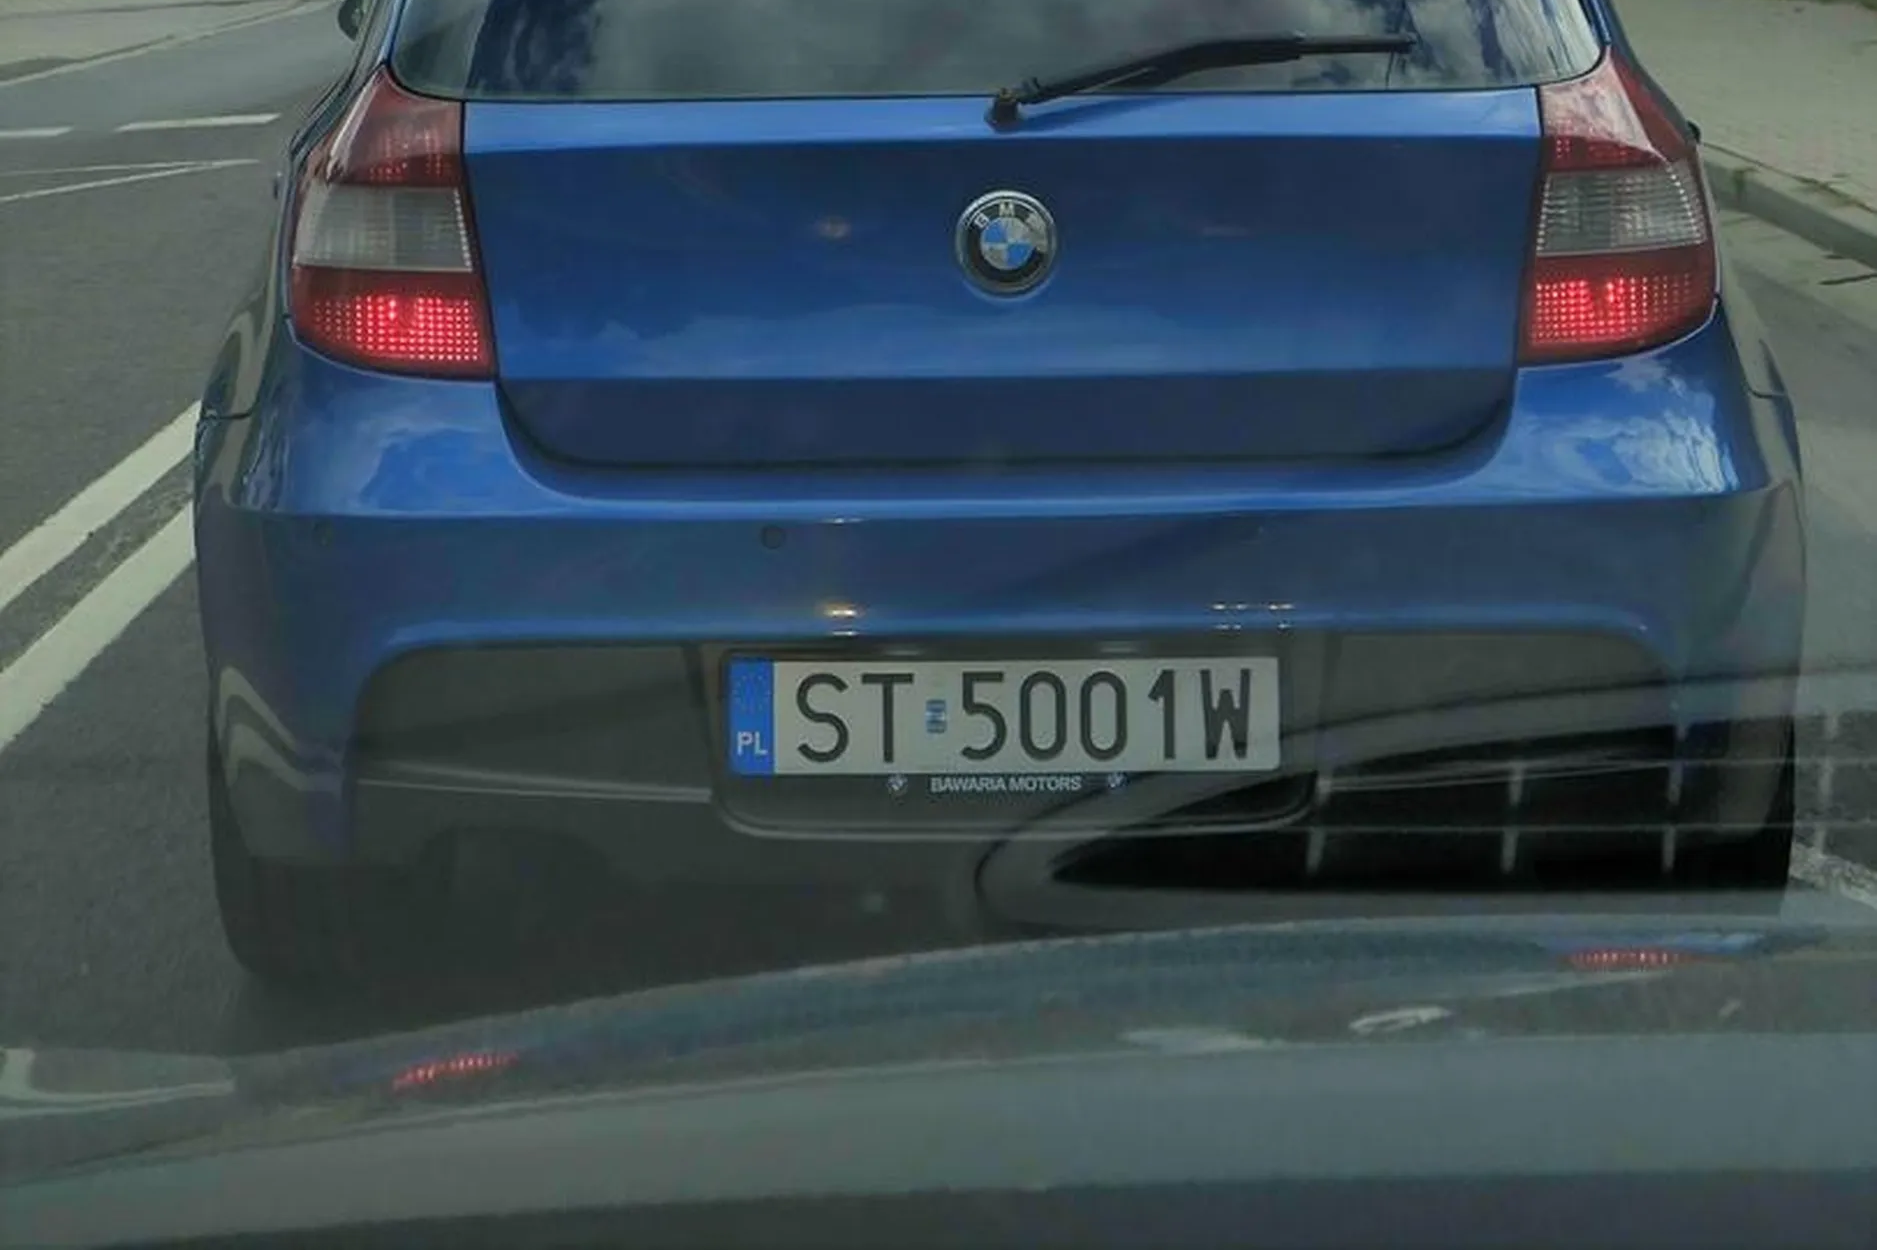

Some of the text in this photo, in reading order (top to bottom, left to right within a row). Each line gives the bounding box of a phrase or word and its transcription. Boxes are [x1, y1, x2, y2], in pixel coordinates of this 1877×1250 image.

[737, 668, 1251, 764] PL ST 5001W
[931, 775, 1082, 793] BAWARIA MOTORS
